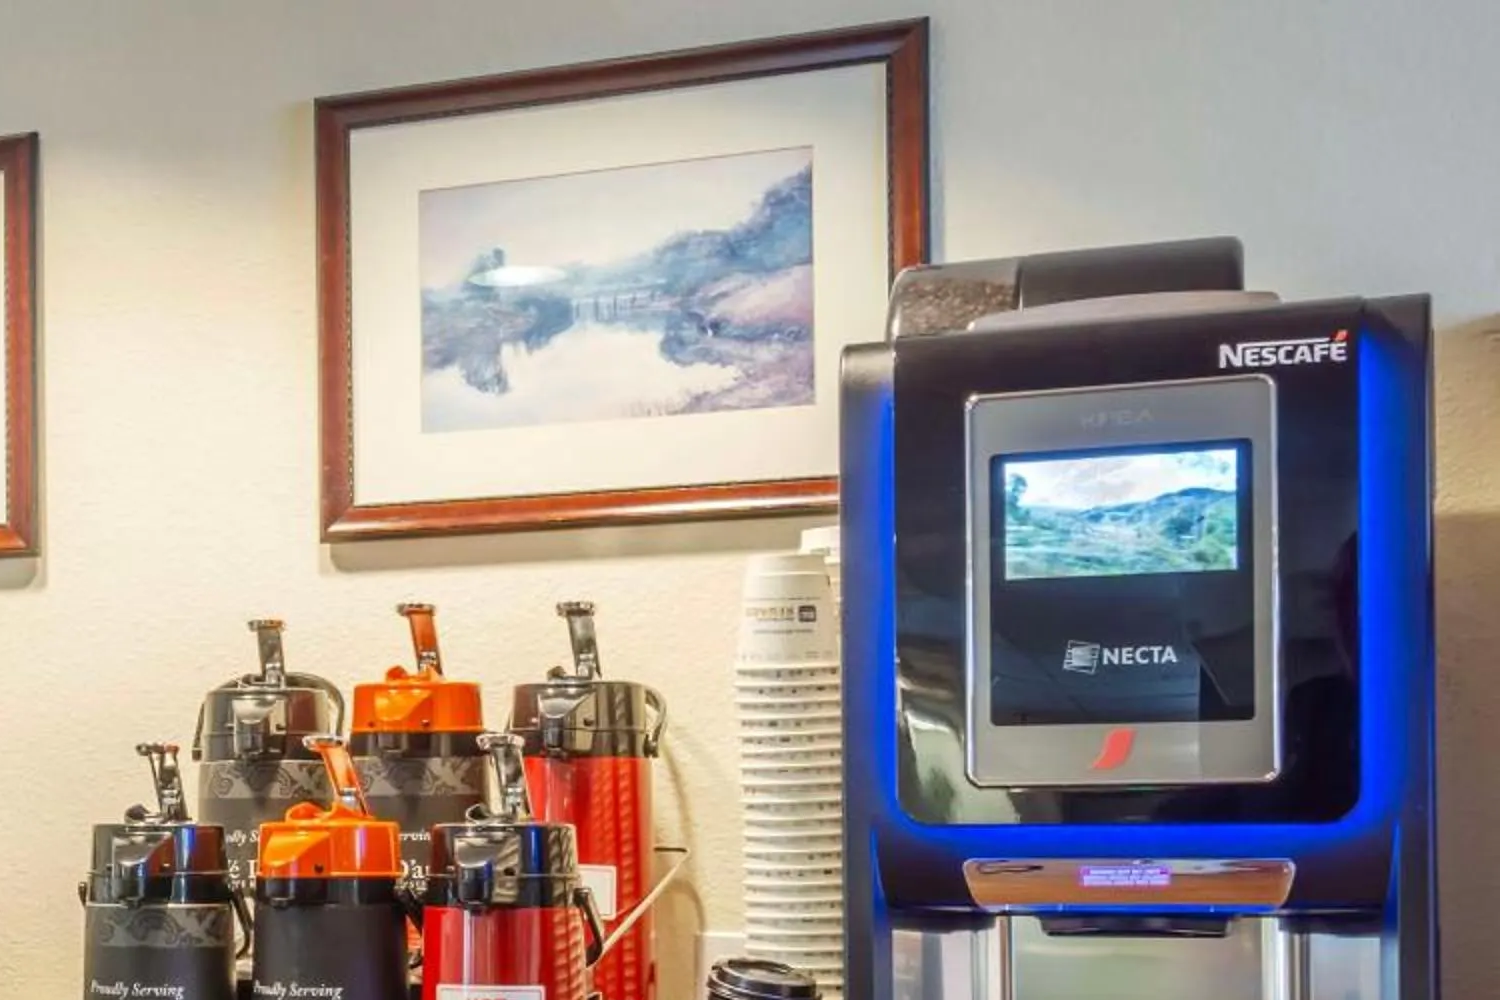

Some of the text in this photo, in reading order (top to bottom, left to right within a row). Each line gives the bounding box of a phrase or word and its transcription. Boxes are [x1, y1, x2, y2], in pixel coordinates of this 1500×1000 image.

[1219, 329, 1348, 368] NESCAFÉ
[1102, 645, 1179, 665] NECTA
[91, 979, 185, 1000] Proudly Serving
[253, 980, 287, 1000] Proudly
